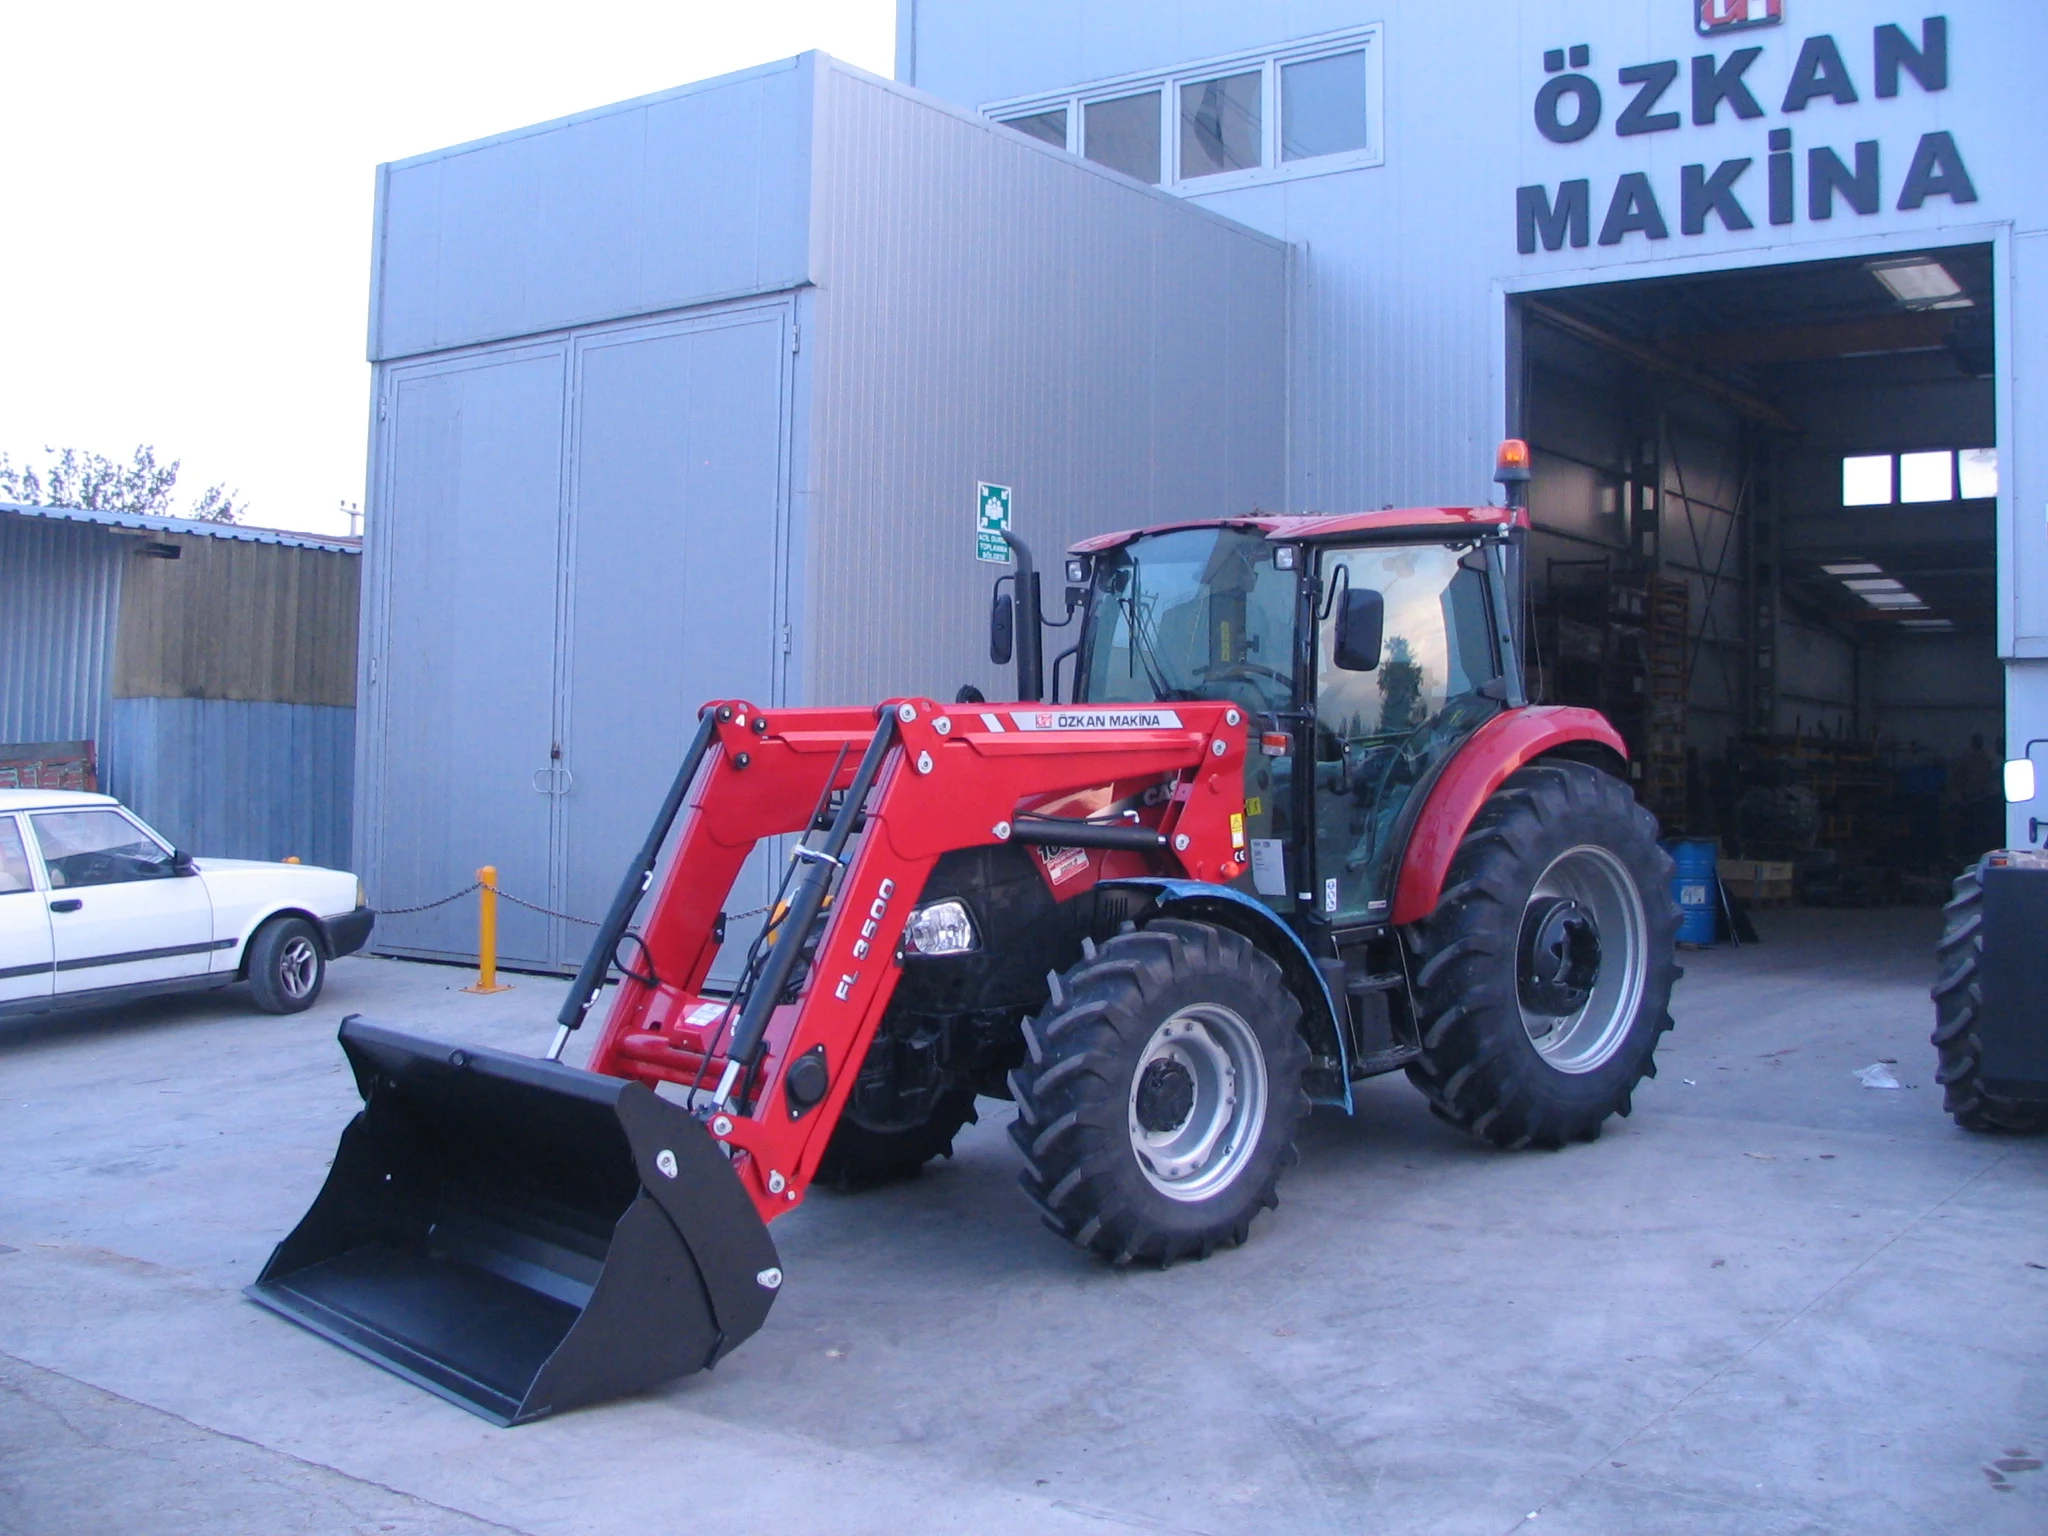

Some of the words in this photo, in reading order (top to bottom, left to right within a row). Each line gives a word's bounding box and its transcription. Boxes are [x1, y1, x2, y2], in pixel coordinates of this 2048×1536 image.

[1534, 15, 1949, 144] ÖZKAN
[1516, 128, 1978, 254] MAKİNA
[1058, 713, 1106, 728] ÖZKAN
[1109, 712, 1161, 727] MAKİNA
[835, 970, 860, 1001] FL
[853, 878, 896, 961] 3500
